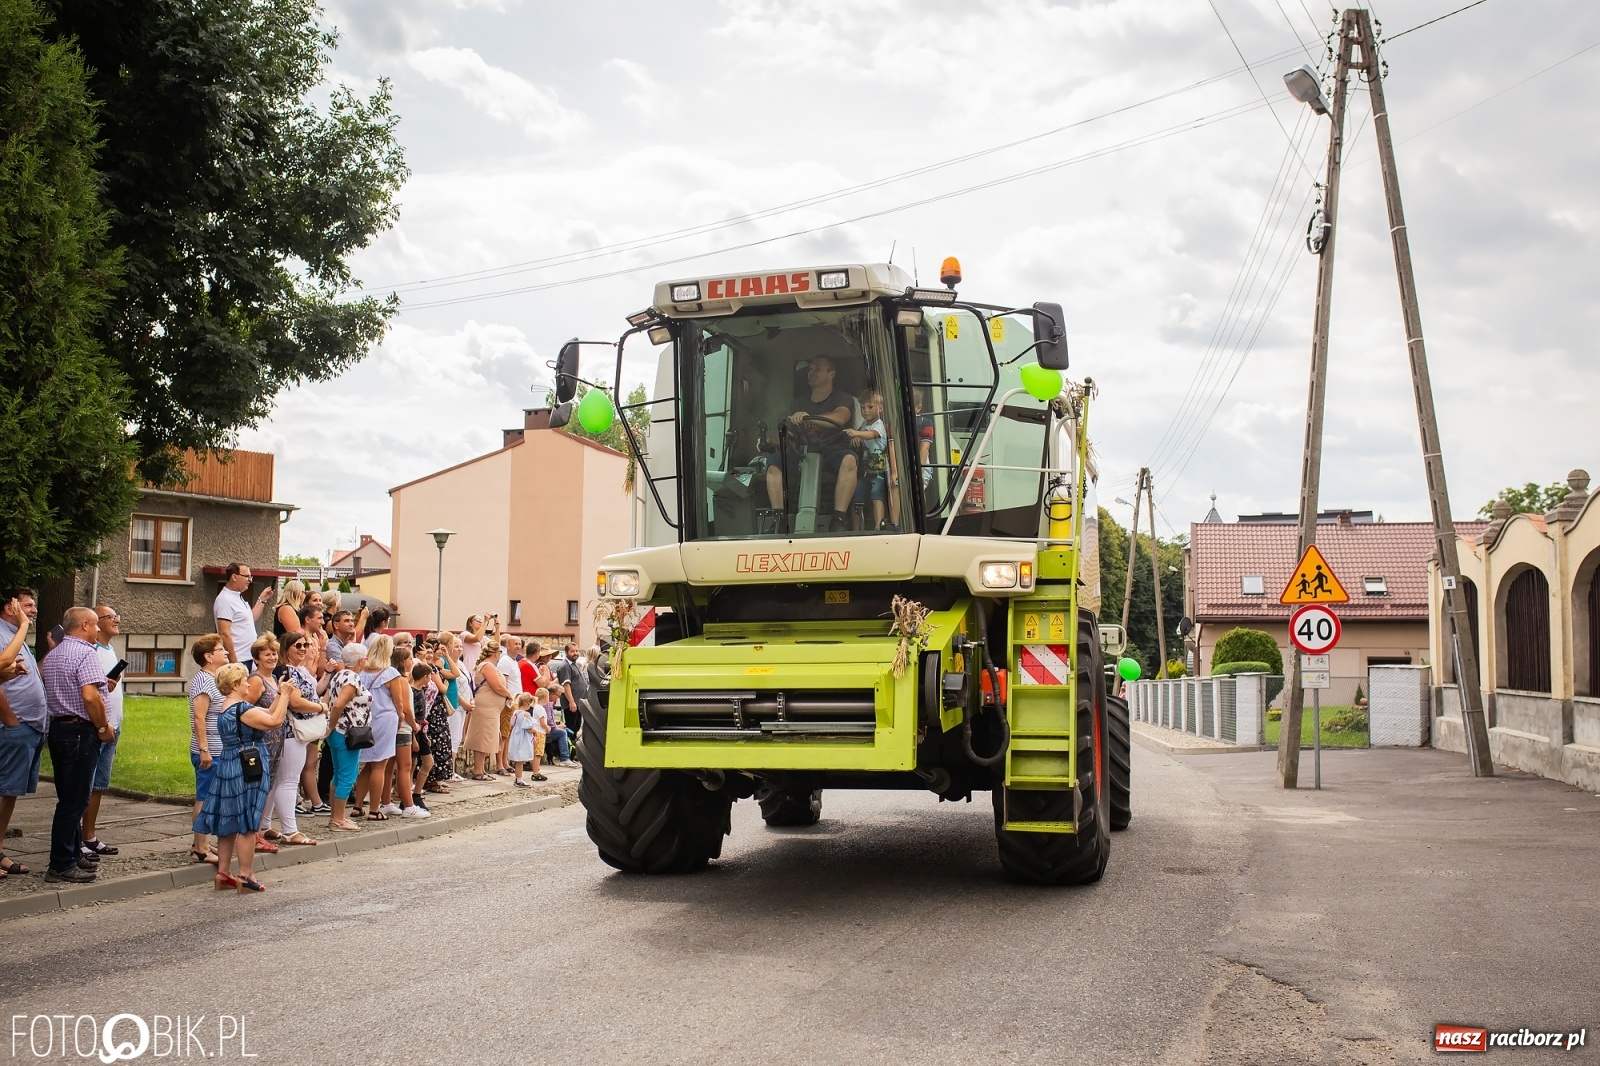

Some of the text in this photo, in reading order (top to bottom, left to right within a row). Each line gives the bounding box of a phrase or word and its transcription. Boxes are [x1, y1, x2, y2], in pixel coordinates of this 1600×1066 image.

[707, 272, 809, 299] CLAAS
[736, 551, 850, 573] LEXION
[1297, 618, 1333, 641] 40
